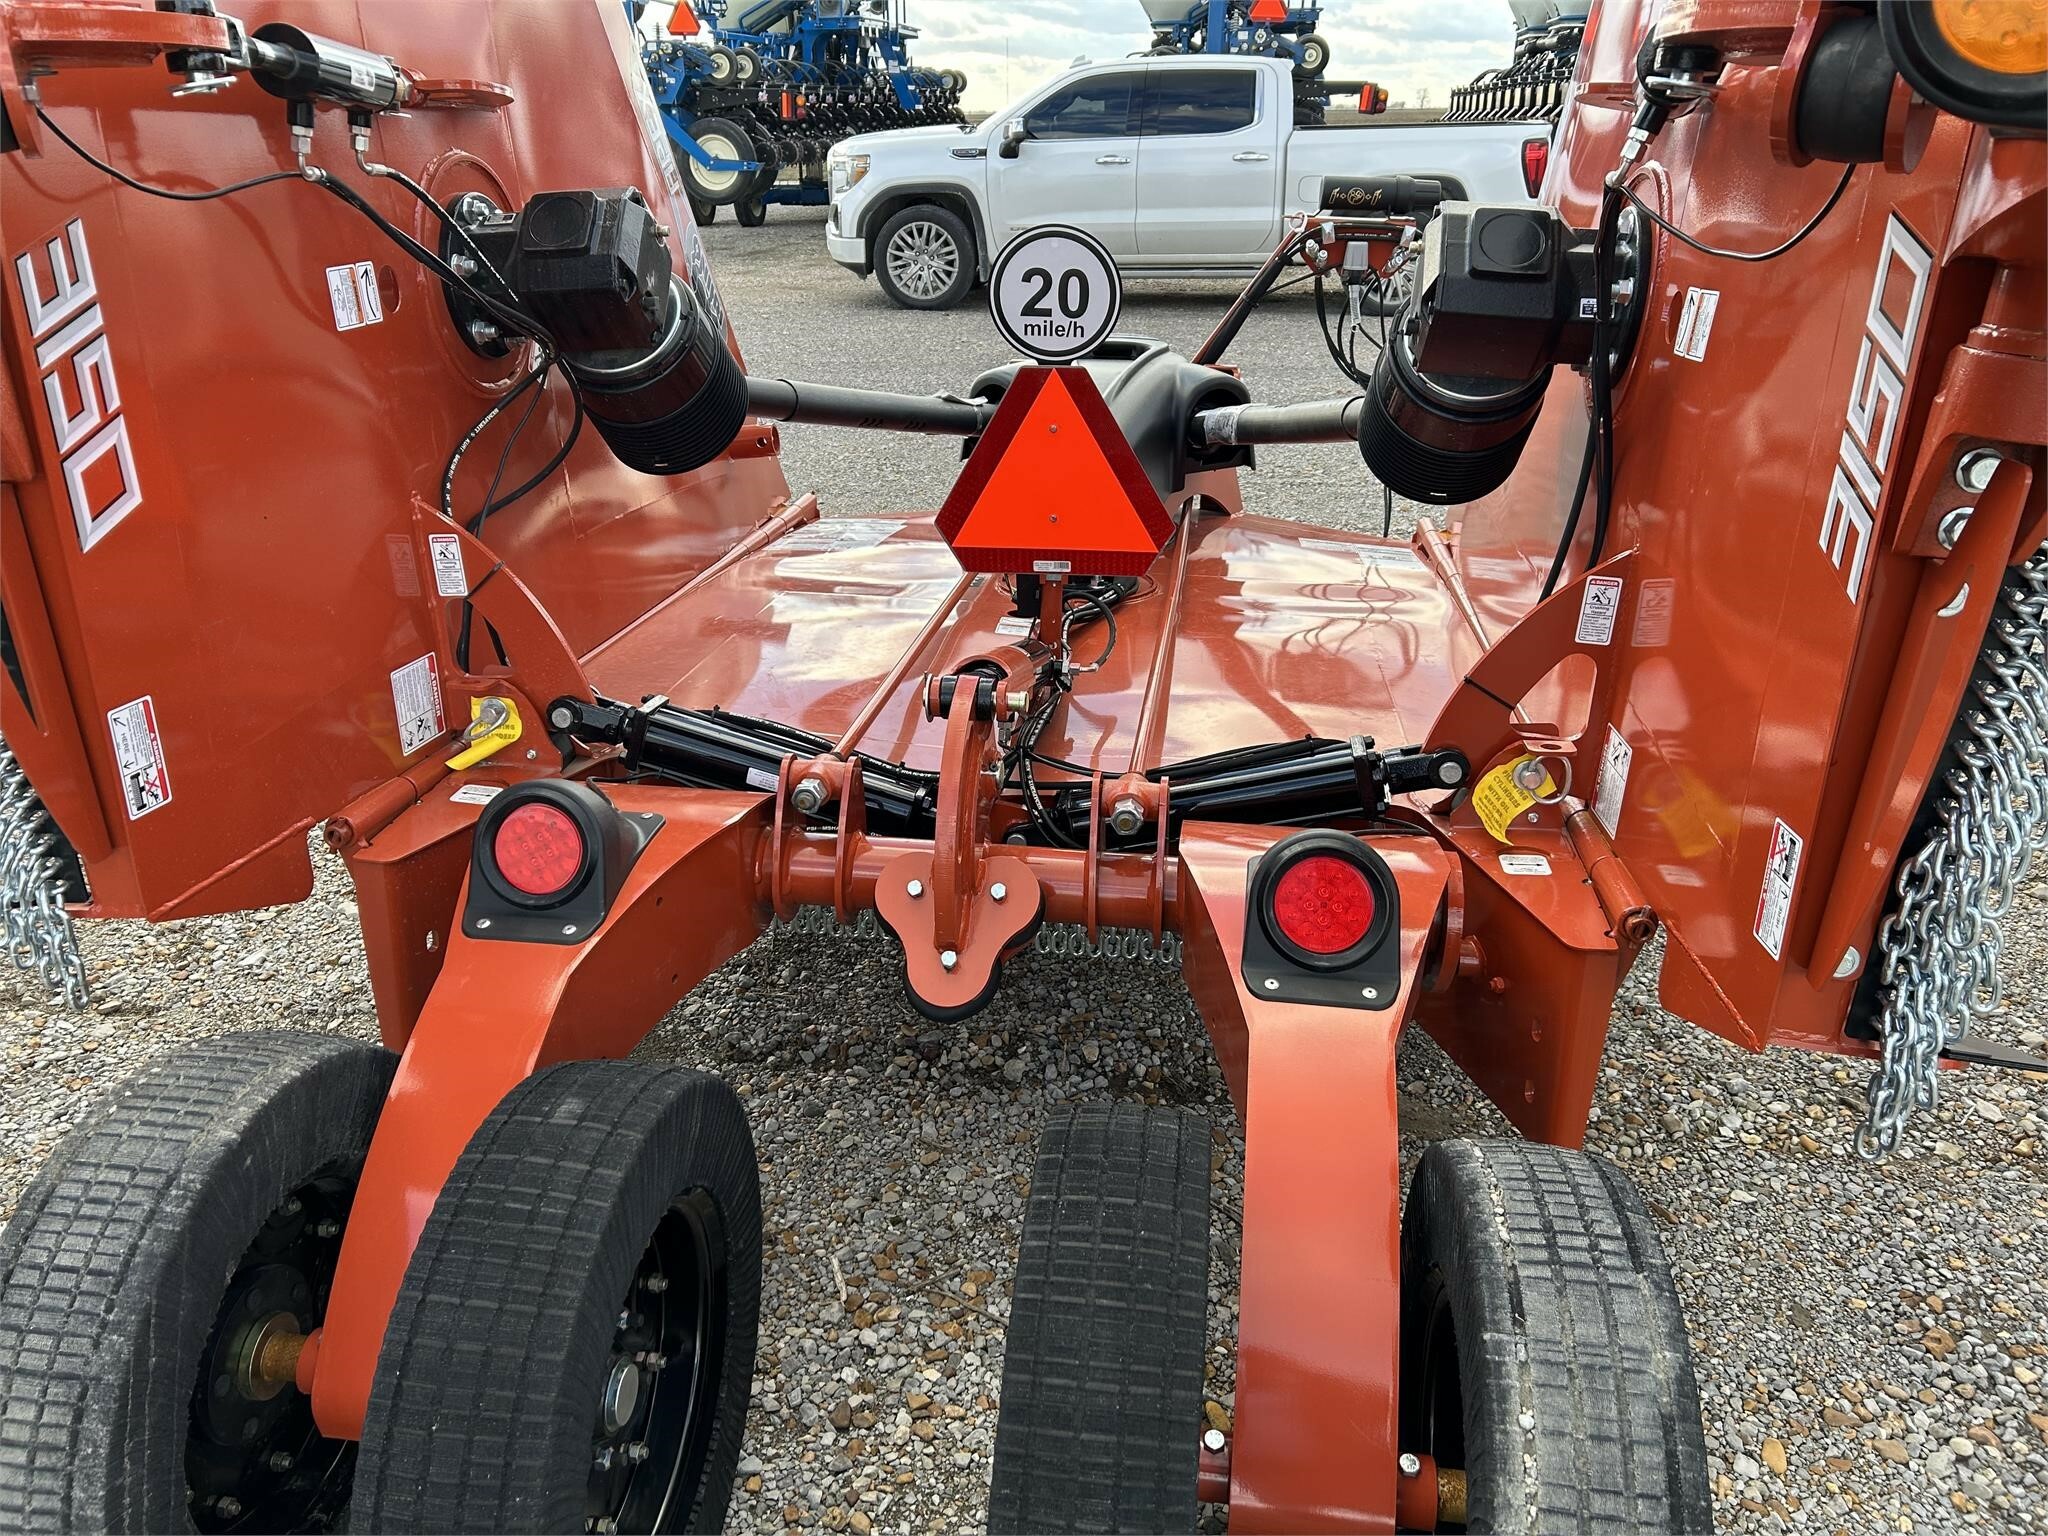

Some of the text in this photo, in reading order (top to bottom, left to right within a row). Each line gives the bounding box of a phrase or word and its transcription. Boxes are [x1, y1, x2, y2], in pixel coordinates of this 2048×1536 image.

[1019, 267, 1090, 319] 20
[1023, 320, 1085, 338] mile/h
[15, 216, 143, 554] 3150
[1818, 212, 1935, 606] 3150
[431, 680, 441, 718] DANGER
[121, 732, 131, 755] HERE
[152, 740, 162, 770] DANGER
[1598, 743, 1609, 785] DANGER
[1487, 784, 1502, 802] WITH
[1500, 801, 1510, 813] OIL
[1492, 775, 1521, 808] CYLINDERS
[1775, 905, 1783, 929] HERE
